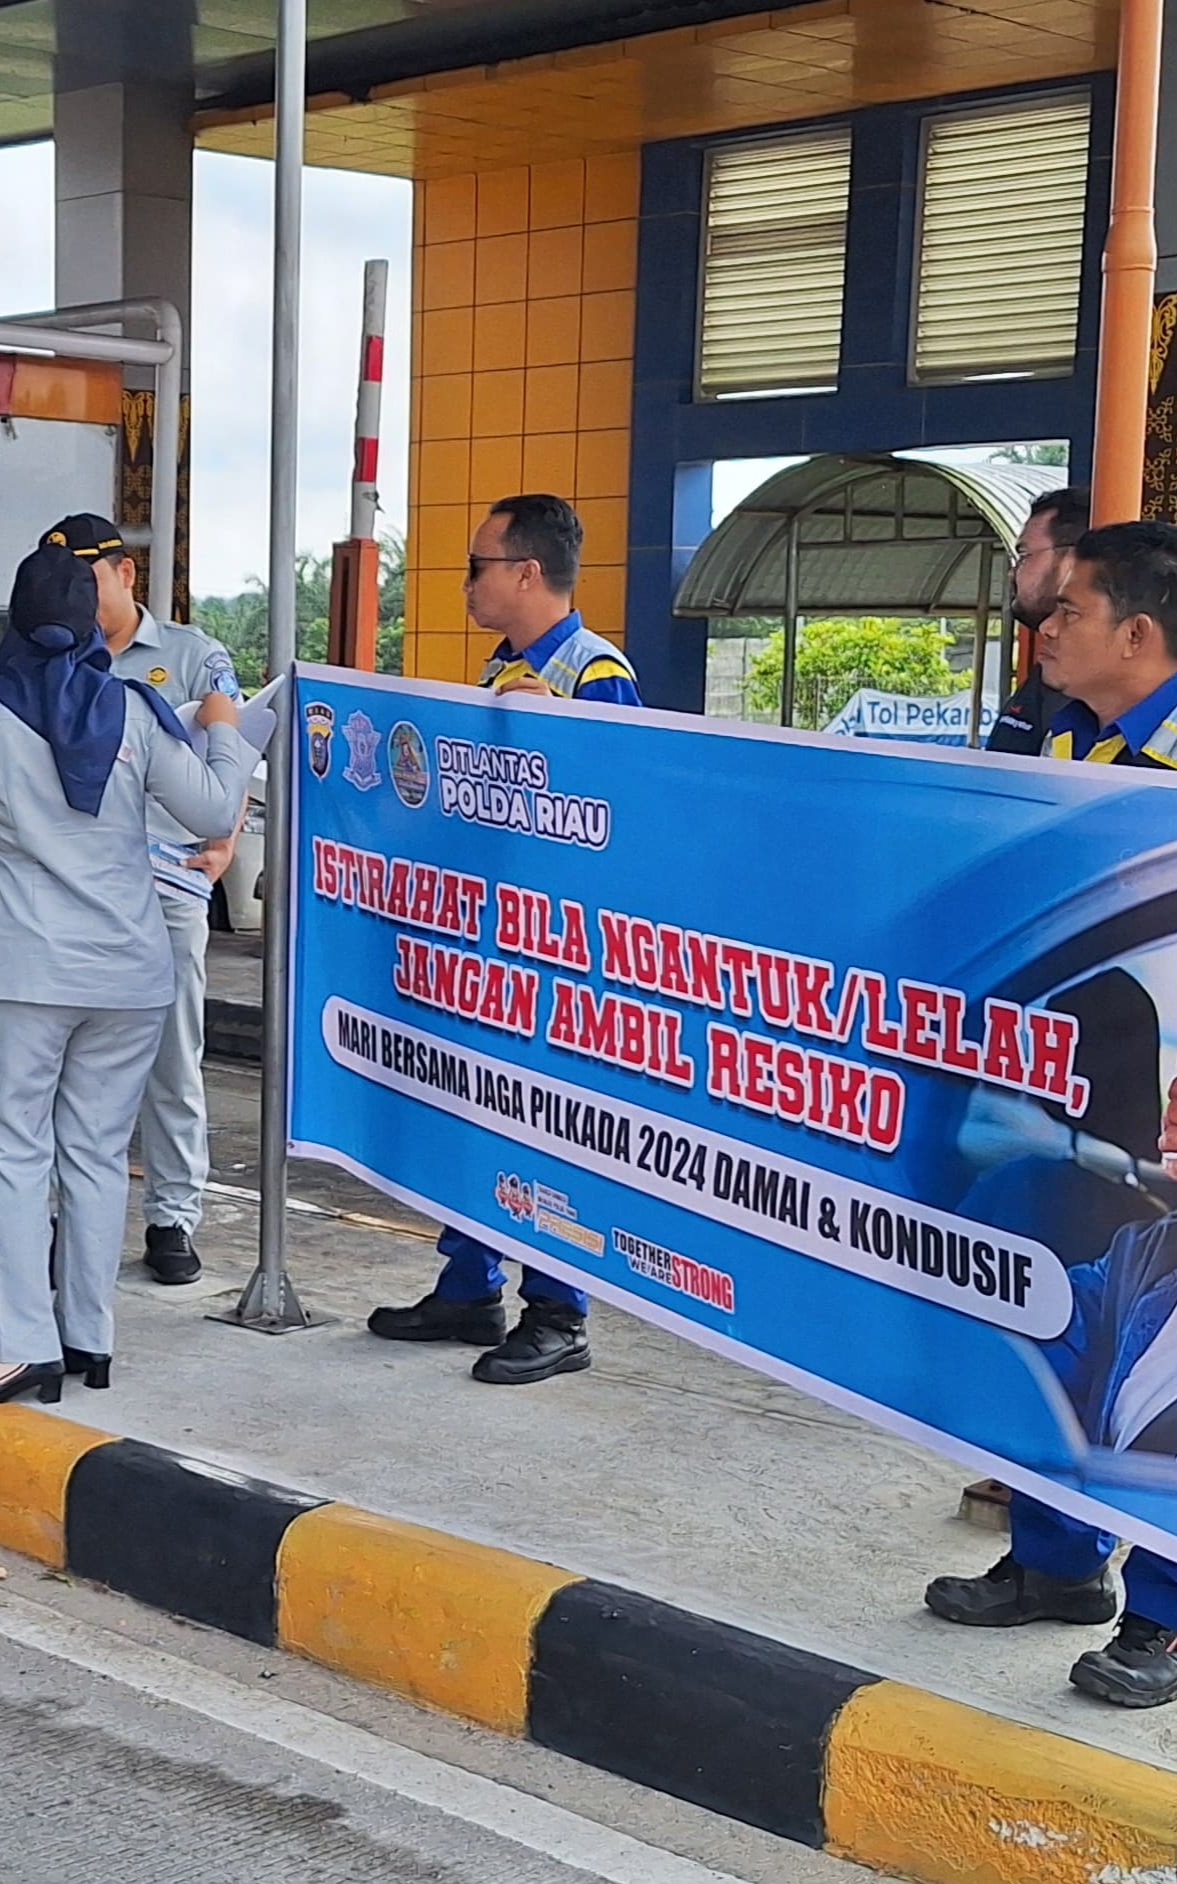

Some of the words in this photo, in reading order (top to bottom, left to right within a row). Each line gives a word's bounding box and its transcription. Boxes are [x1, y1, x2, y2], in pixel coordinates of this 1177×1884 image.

[868, 701, 898, 726] Tol
[437, 739, 546, 788] DITLANTAS
[442, 776, 531, 832] POLDA
[536, 794, 608, 847] RIAU
[315, 839, 485, 939] ISTIRAHAT
[498, 886, 589, 967] BILA
[601, 914, 1085, 1111] NGANTUK/LELAH,
[395, 938, 536, 1032] JANGAN
[549, 982, 692, 1082] AMBIL
[709, 1027, 902, 1146] RESIKO
[338, 1010, 377, 1063] MARI
[381, 1028, 471, 1101] BERSAMA
[475, 1065, 526, 1123] JAGA
[530, 1085, 631, 1164] PILKADA
[637, 1125, 708, 1191] 2024
[713, 1150, 811, 1231] DAMAI
[817, 1196, 841, 1243] &
[850, 1198, 1032, 1308] KONDUSIF
[613, 1229, 672, 1268] TOGETHER
[672, 1254, 734, 1311] STRONG
